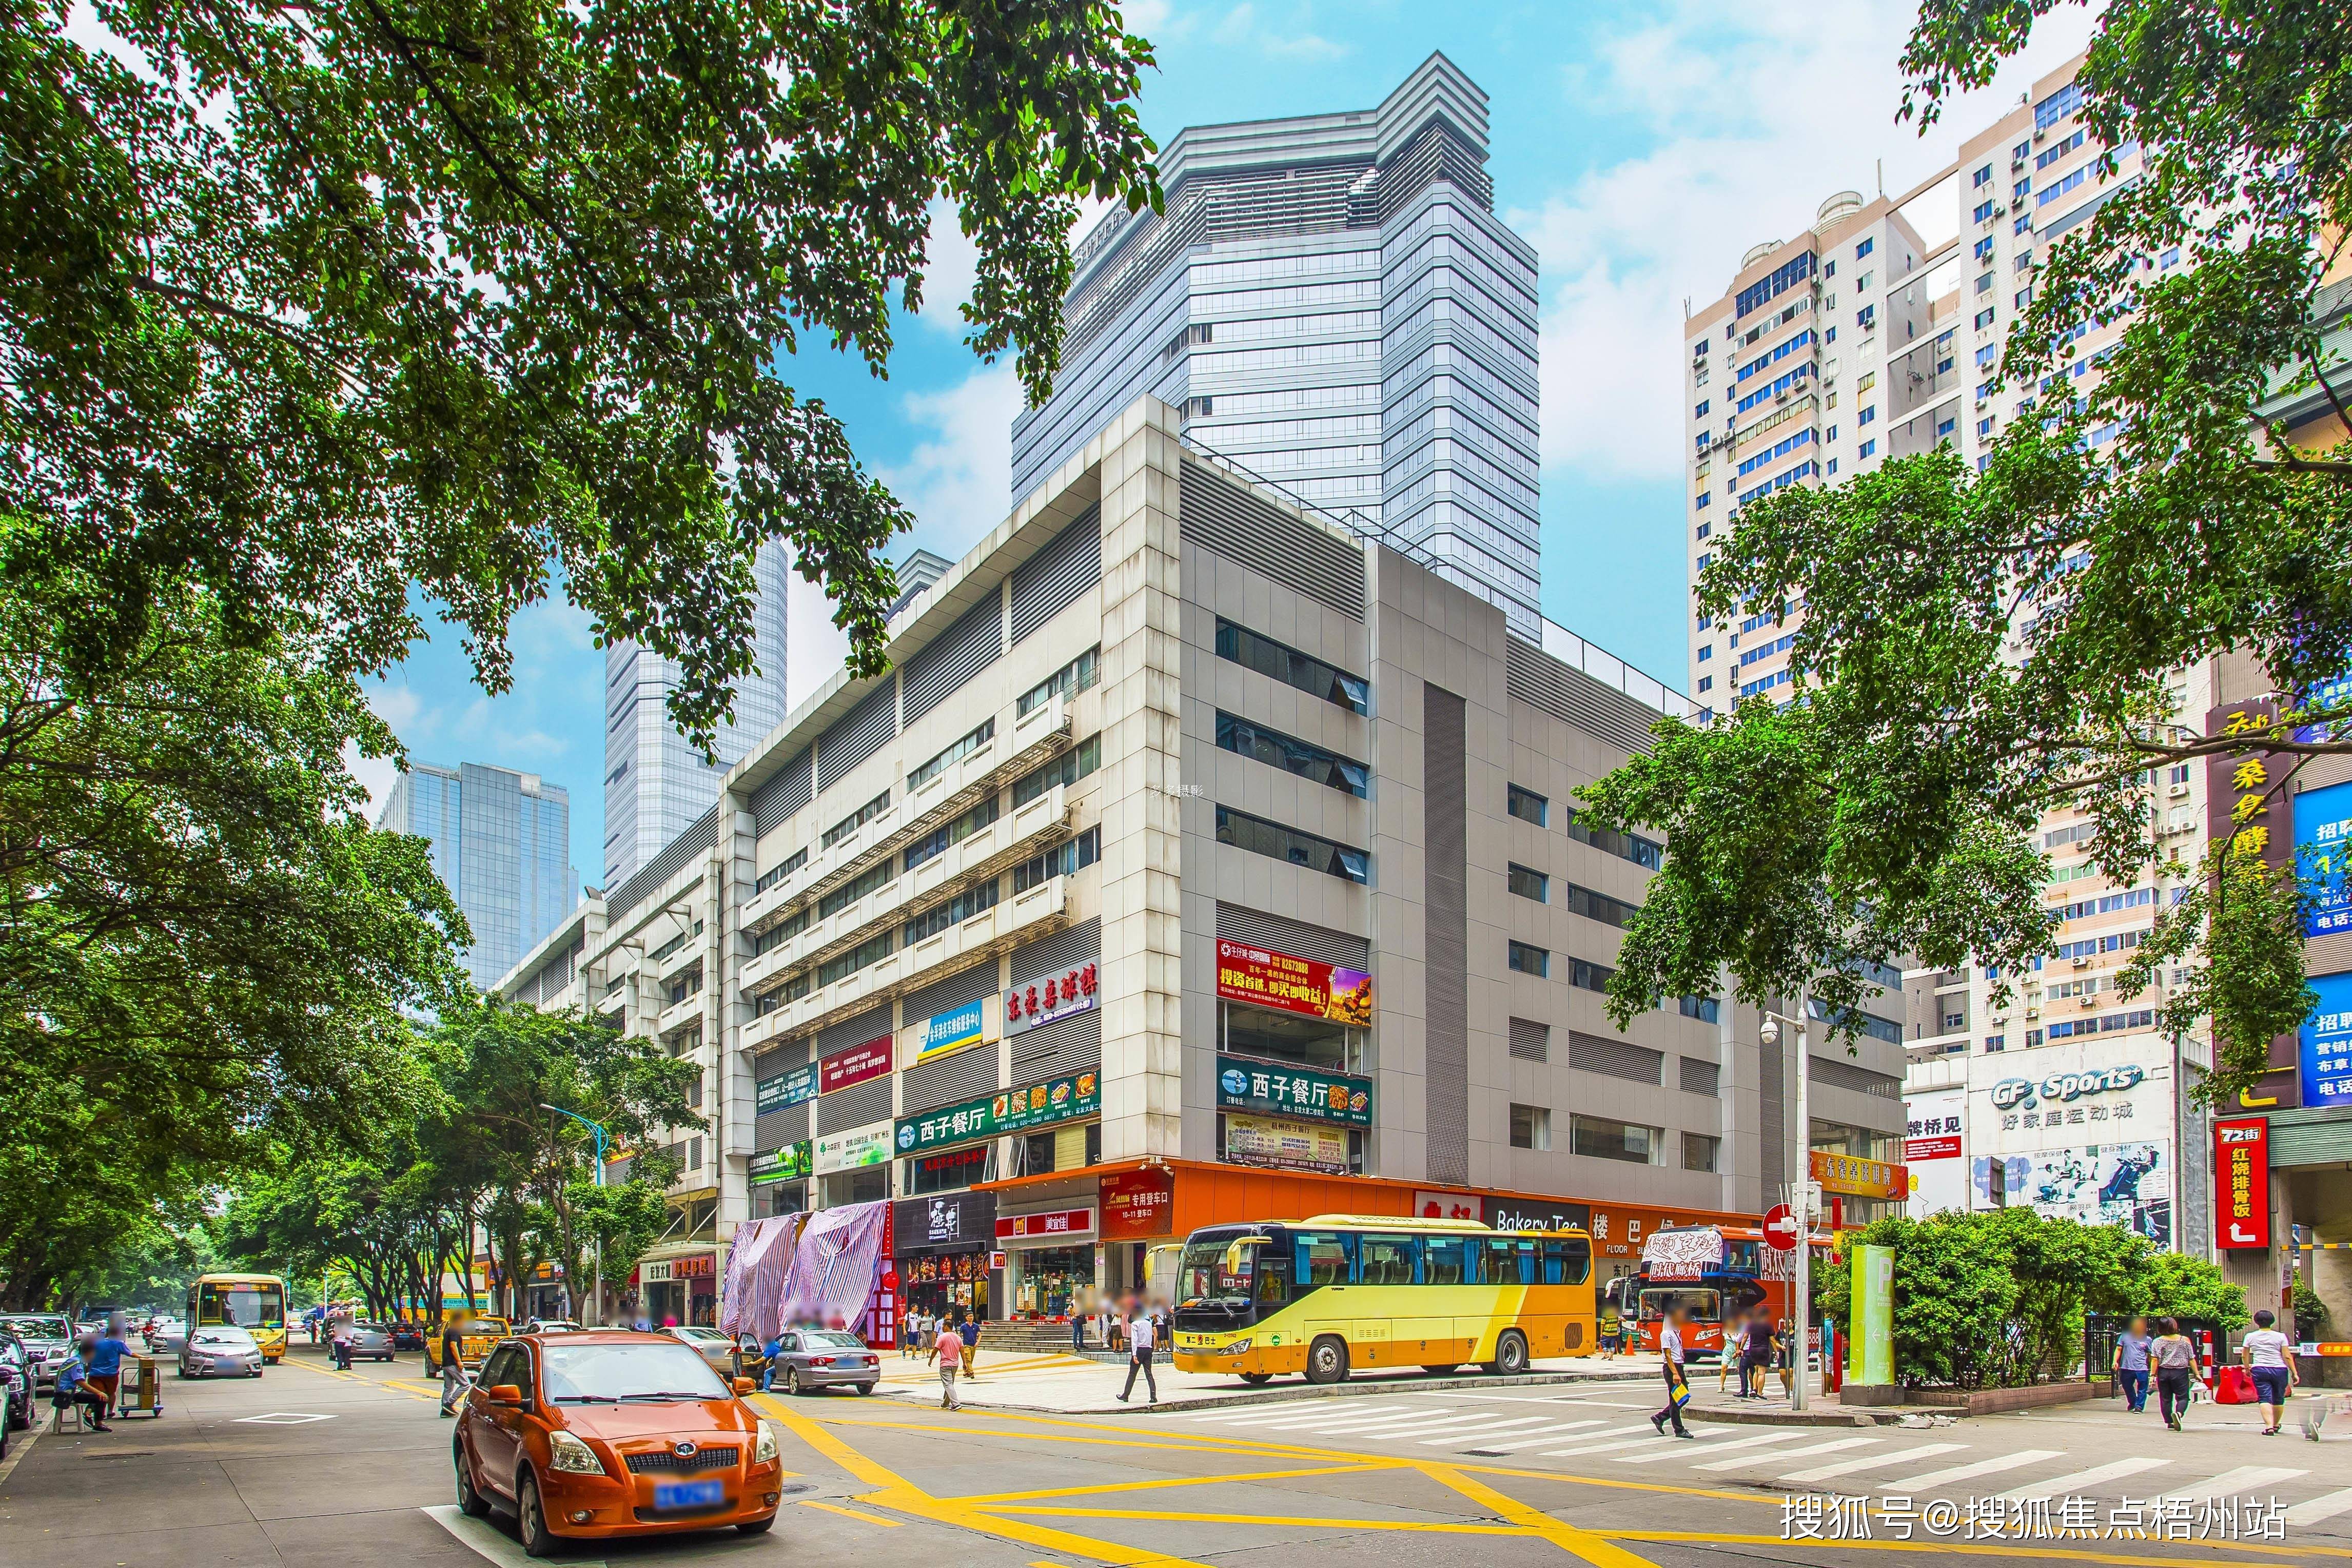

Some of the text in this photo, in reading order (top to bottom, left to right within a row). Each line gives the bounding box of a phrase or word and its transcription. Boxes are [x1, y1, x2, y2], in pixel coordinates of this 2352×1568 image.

[1281, 958, 1308, 974] 82673888
[1249, 965, 1308, 985] 百年一遇的商业综合体
[1251, 1072, 1328, 1107] 西子餐厅
[1992, 1082, 2026, 1105] GF
[2002, 1101, 2133, 1130] 好家庭运动城
[919, 1107, 986, 1142] 西子餐厅
[1271, 1122, 1311, 1134] 杭州西子餐厅
[2221, 1128, 2259, 1142] 72街
[2034, 1150, 2063, 1159] 按摩保健
[2101, 1144, 2132, 1153] 健身器材
[1826, 1155, 1891, 1186] 东豪桌球棋牌
[2232, 1147, 2251, 1218] 红烧排骨饭
[1132, 1191, 1168, 1207] 专用登车口
[1137, 1209, 1152, 1218] 登车口
[1497, 1209, 1578, 1231] Bakery Tea
[1046, 1216, 1067, 1230] 美宜佳
[1606, 1244, 1628, 1253] FLOOR
[1652, 1261, 1702, 1277] 时代廊桥
[1878, 1257, 1893, 1293] P
